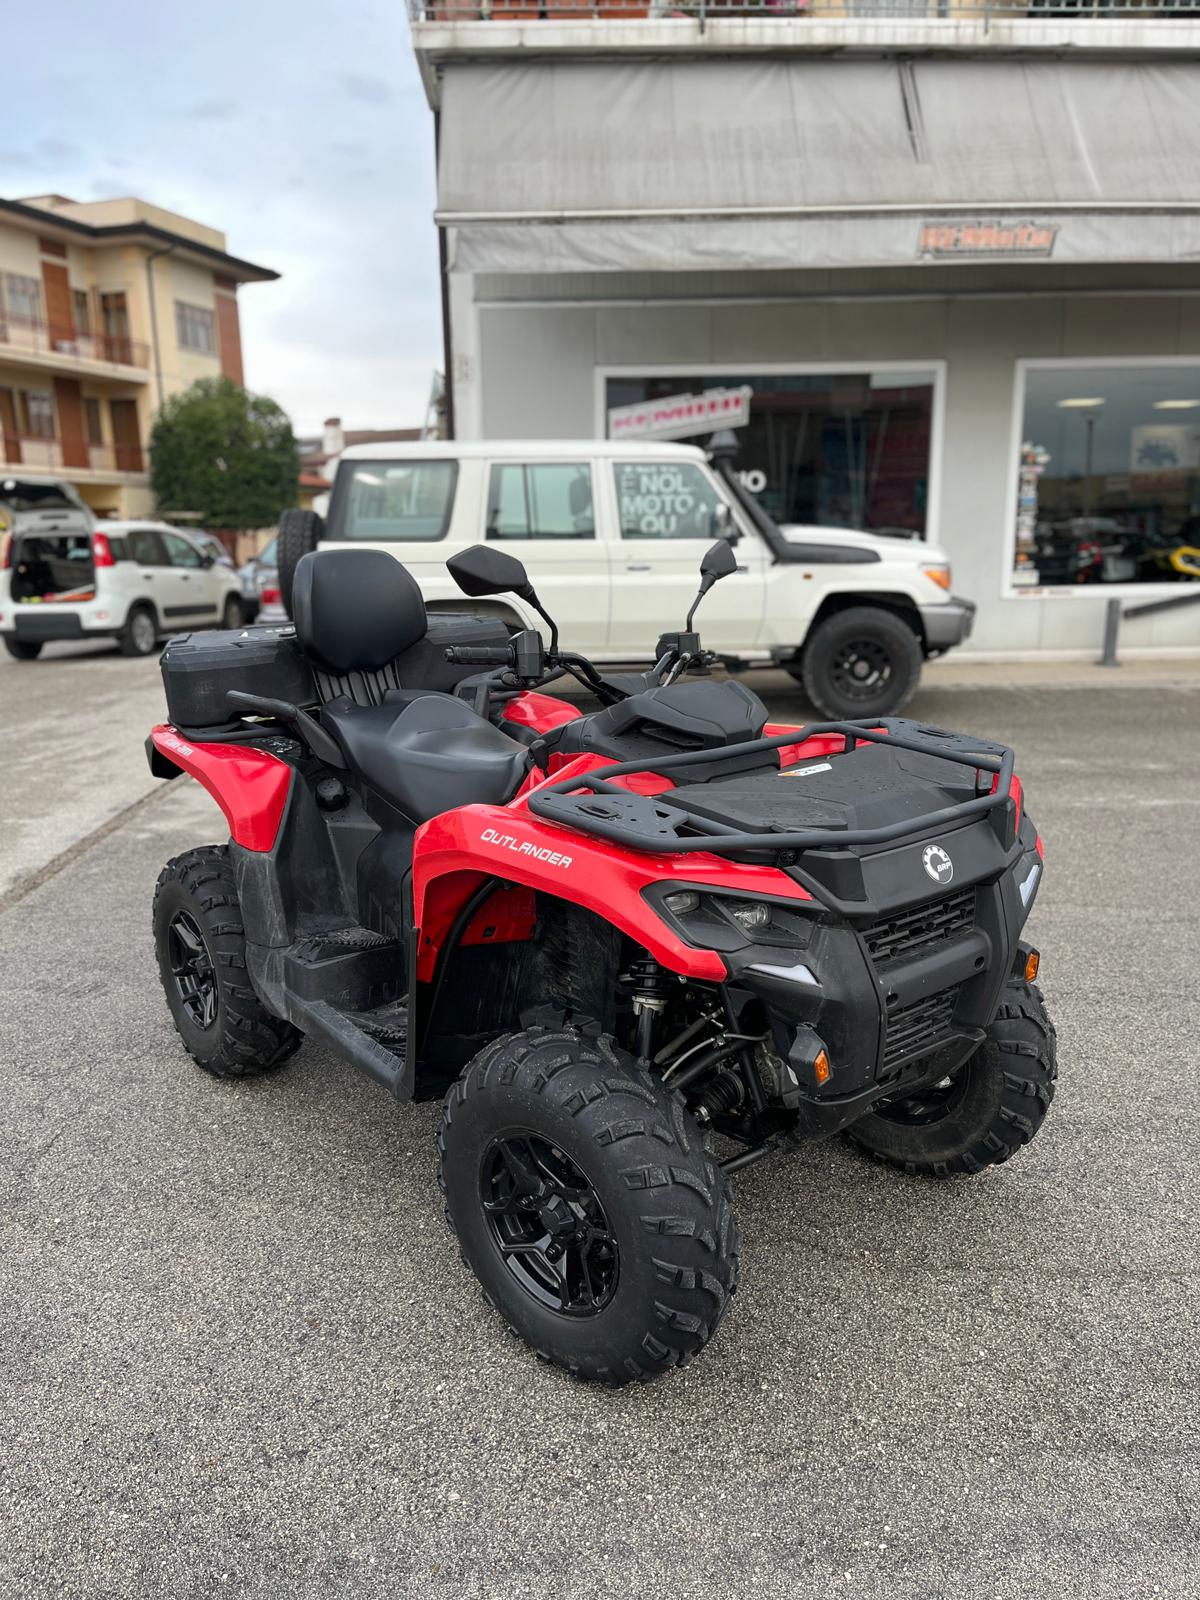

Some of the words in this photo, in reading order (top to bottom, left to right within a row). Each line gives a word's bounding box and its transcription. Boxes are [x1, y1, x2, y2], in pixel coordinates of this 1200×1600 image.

[621, 494, 695, 516] MOTO
[480, 828, 573, 869] OUTLANDER
[937, 861, 951, 872] BRP
